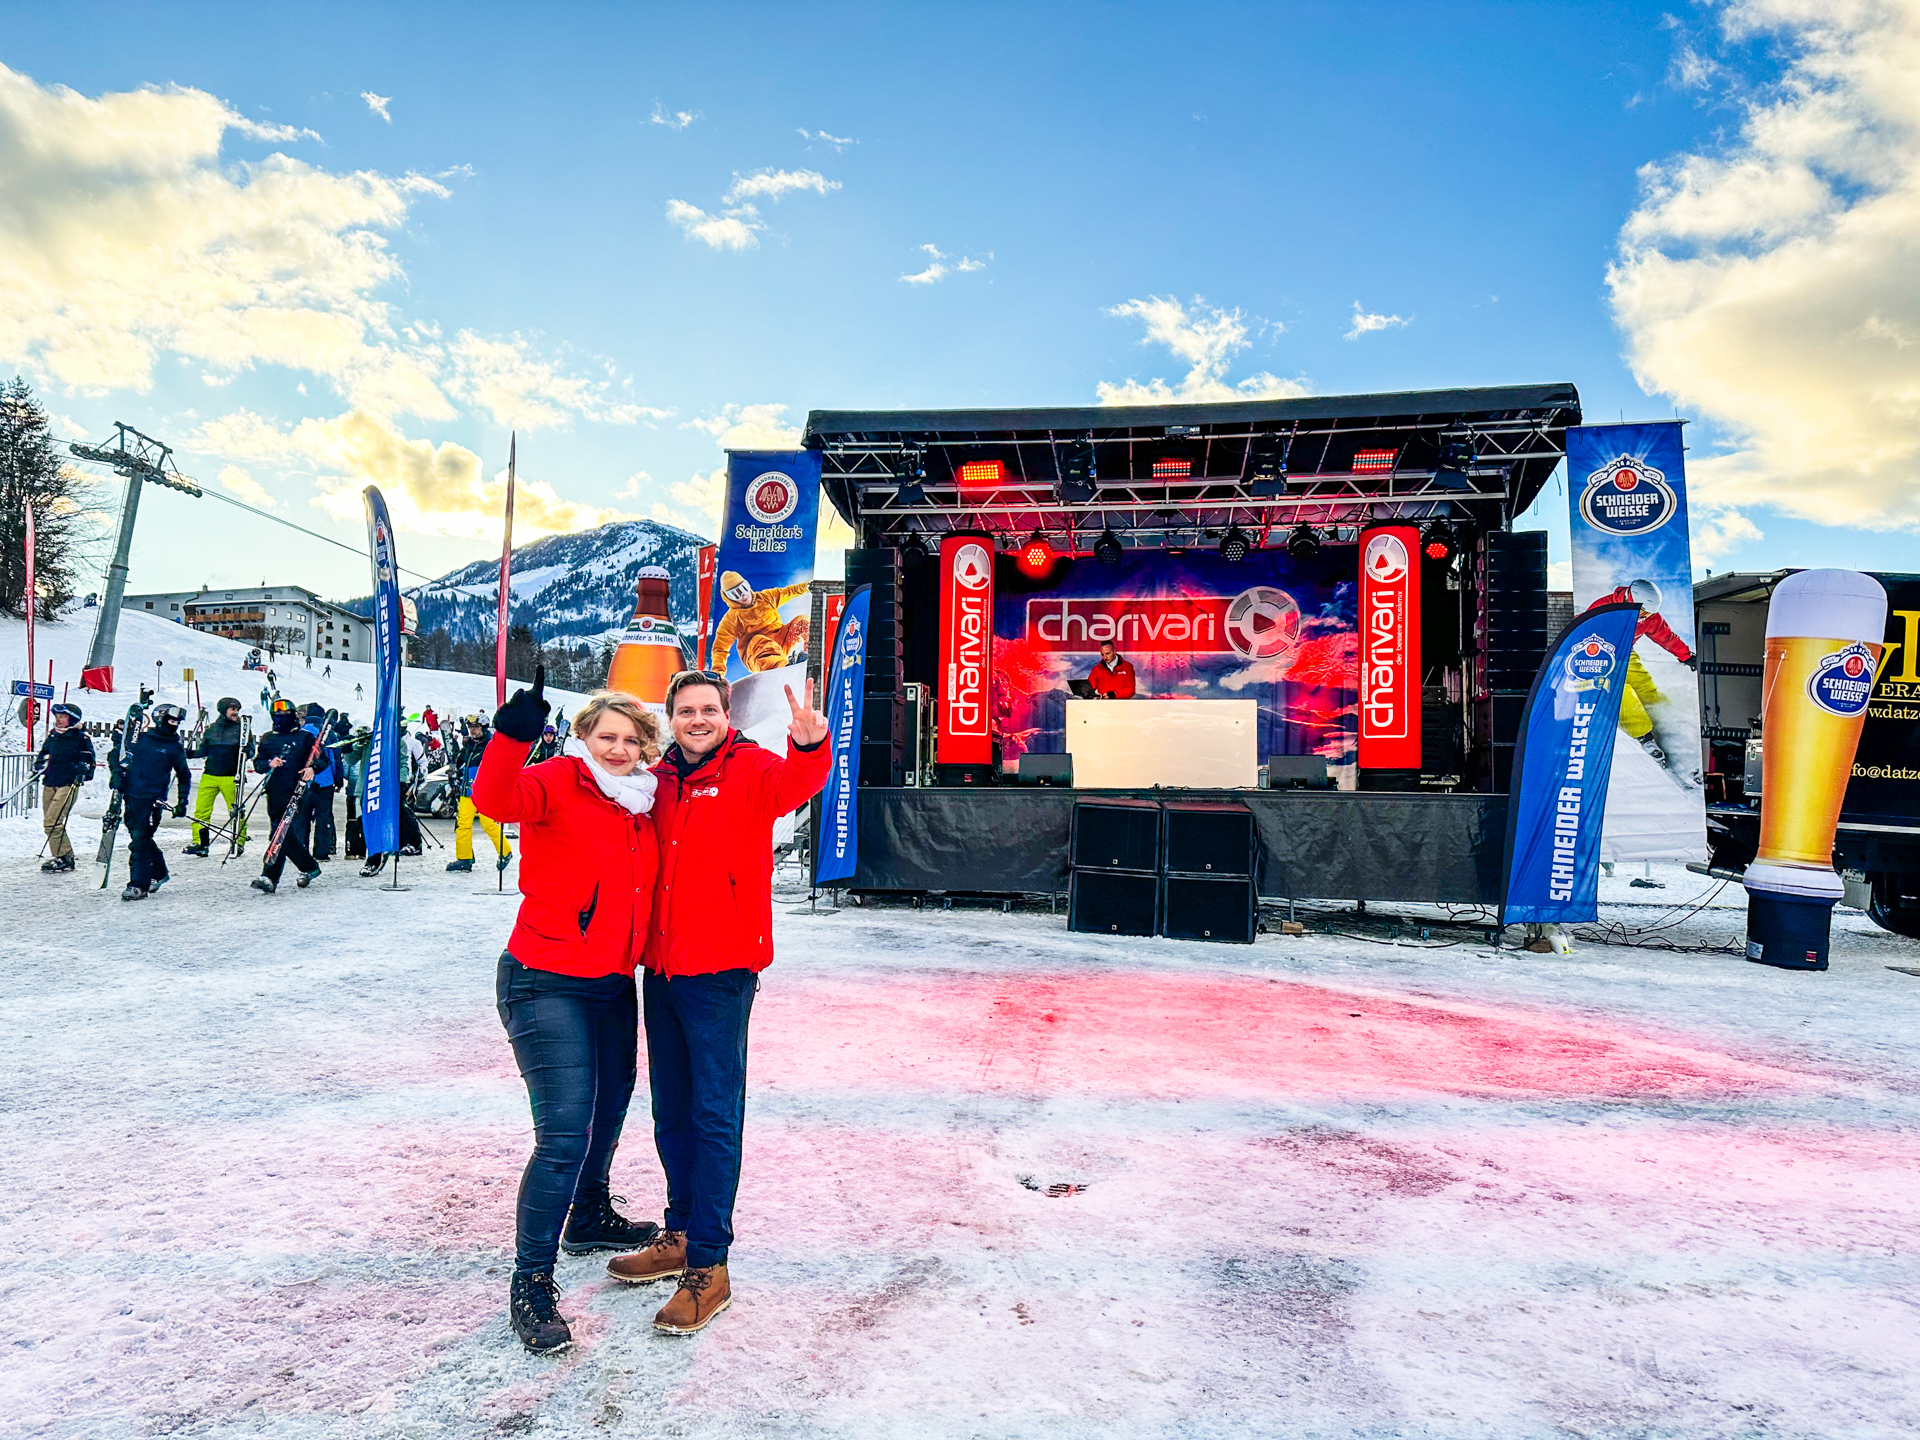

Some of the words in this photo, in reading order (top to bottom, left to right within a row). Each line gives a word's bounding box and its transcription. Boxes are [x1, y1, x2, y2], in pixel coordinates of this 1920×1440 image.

[1596, 493, 1659, 507] SCHNEIDER
[1606, 504, 1650, 518] WEISSE
[736, 525, 802, 539] Schneider's
[749, 539, 787, 552] Helles
[1395, 590, 1403, 622] musikmix
[1037, 600, 1215, 641] charivari
[654, 635, 674, 643] Helles
[1395, 623, 1403, 651] bessere
[952, 597, 982, 726] charivari
[1364, 590, 1395, 728] charivari
[1395, 653, 1403, 666] der
[1574, 659, 1609, 667] SCHNEIDER
[1821, 677, 1871, 694] SCHNEIDER
[1829, 689, 1864, 703] WEISSE
[1565, 702, 1597, 781] WEISSE
[1550, 787, 1582, 902] SCHNEIDER
